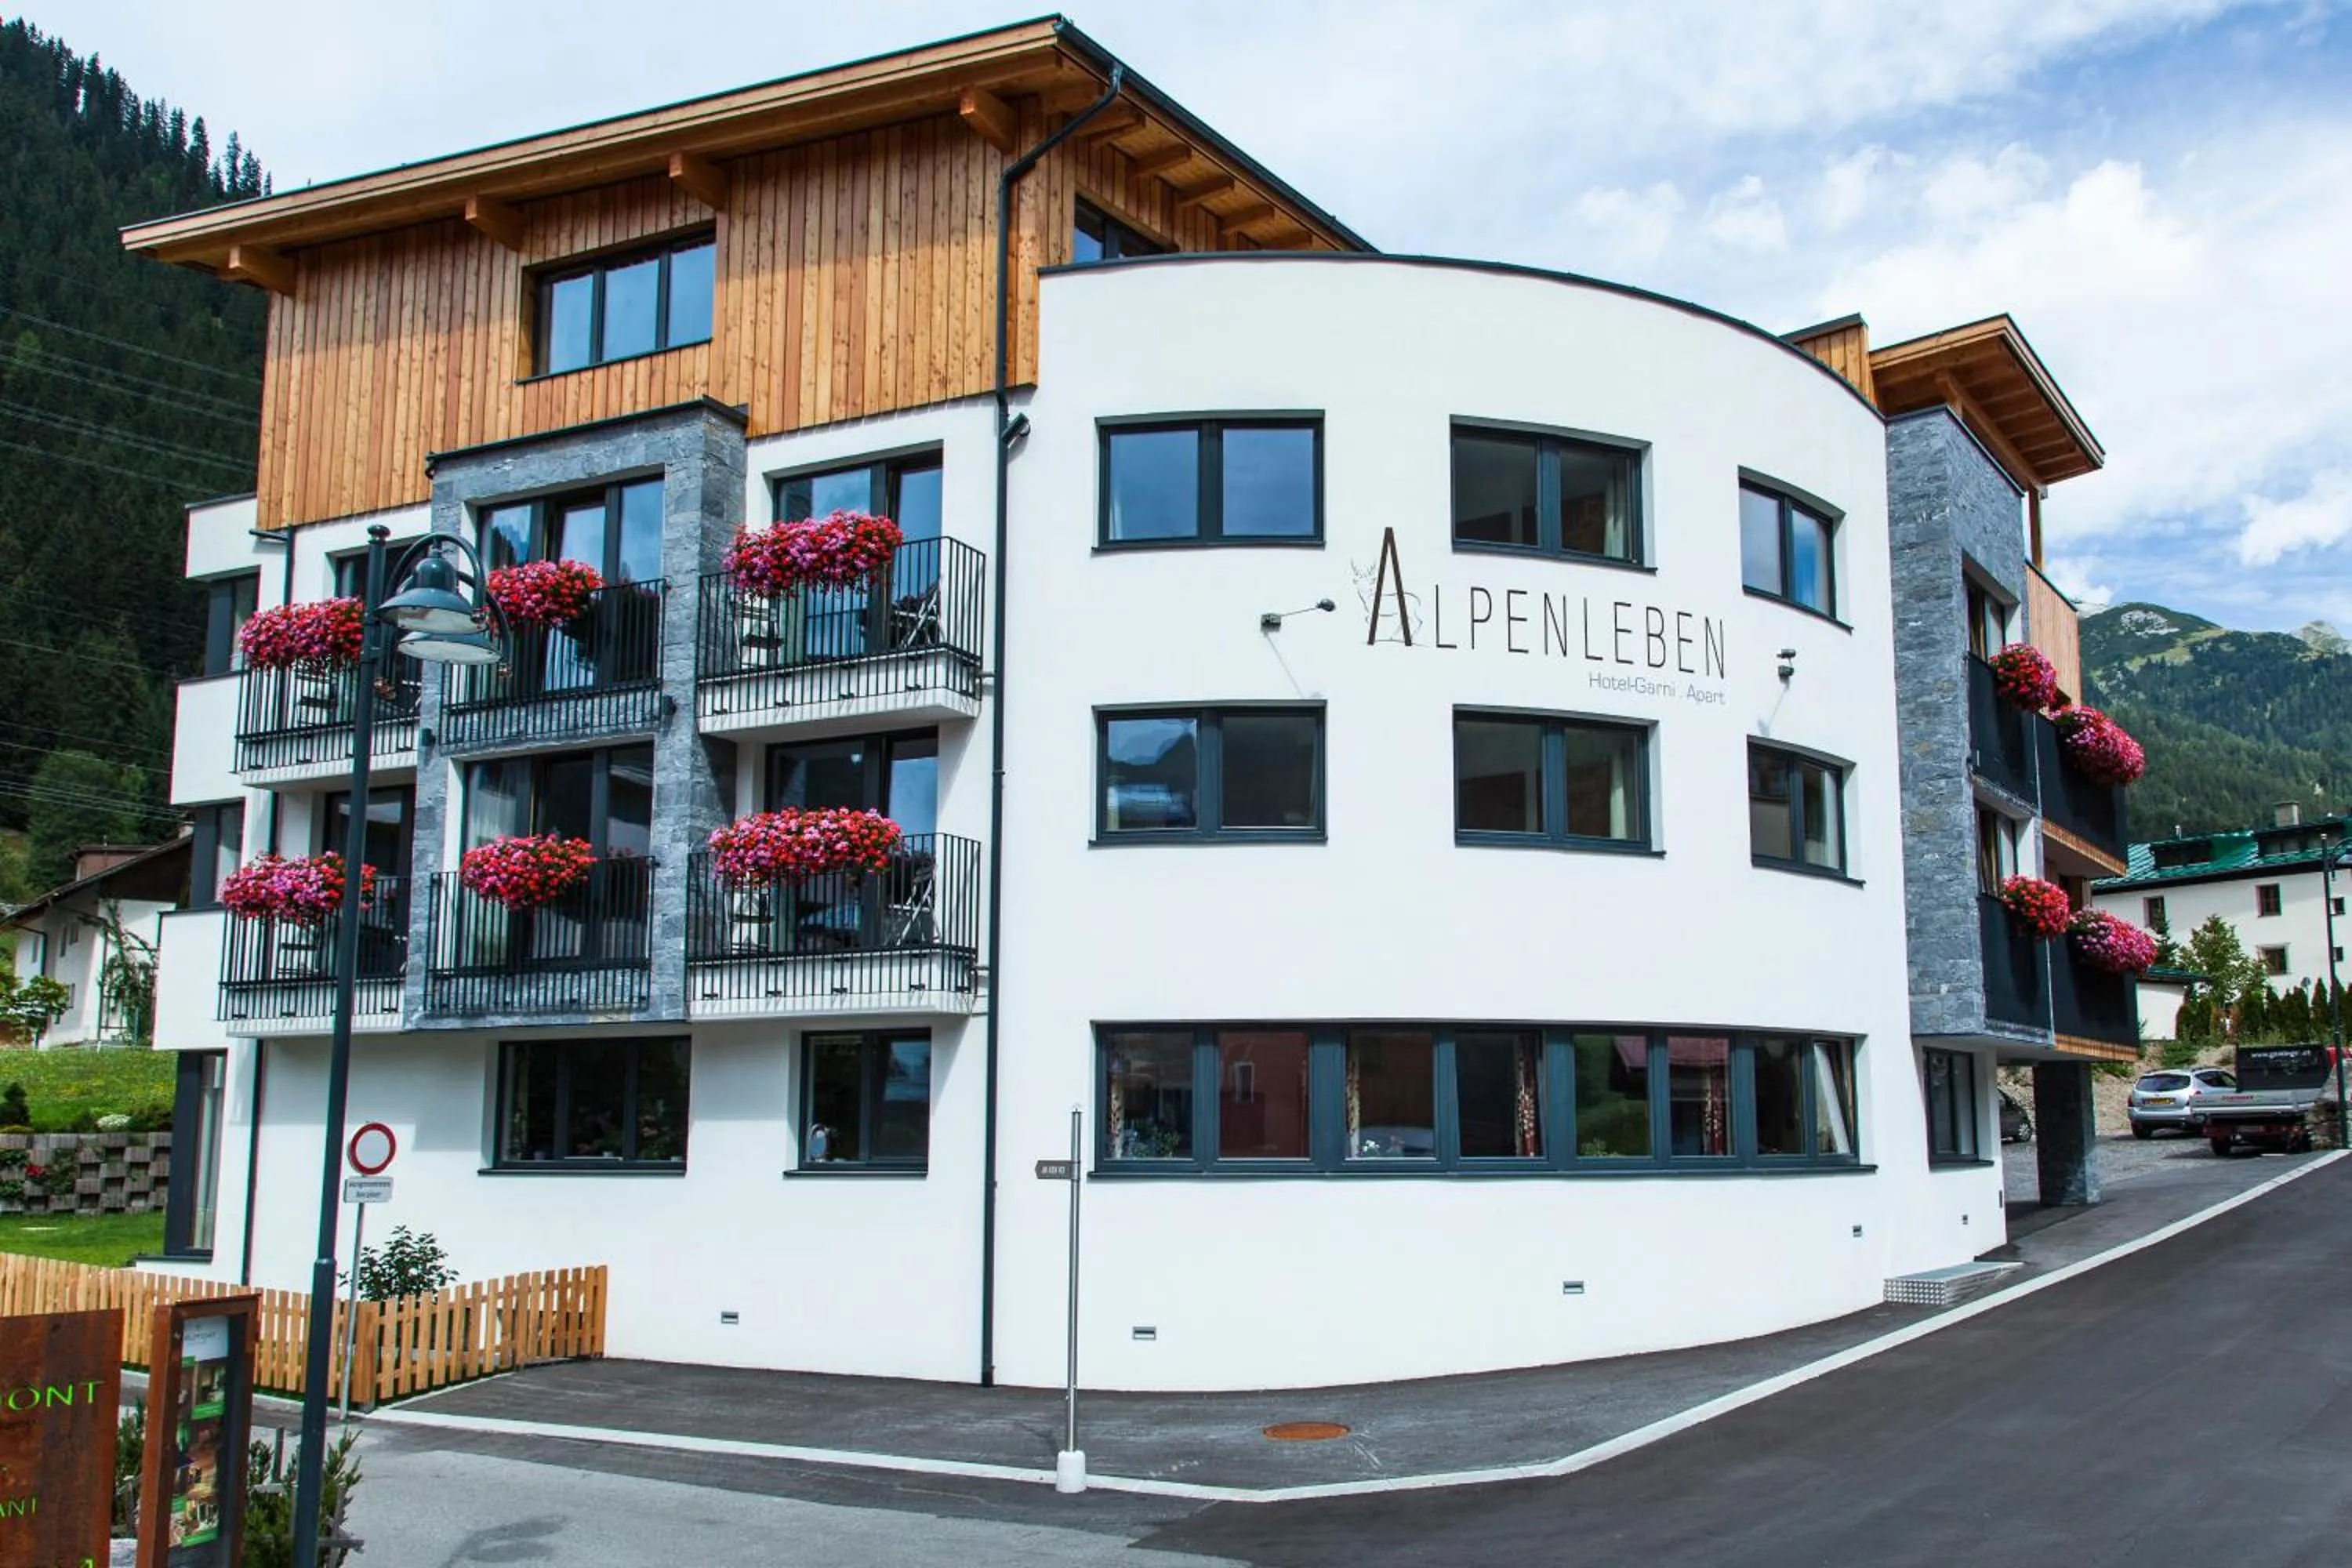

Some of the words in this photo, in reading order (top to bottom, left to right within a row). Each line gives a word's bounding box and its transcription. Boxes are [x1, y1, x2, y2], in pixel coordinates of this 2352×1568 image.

[1367, 526, 1725, 679] ALPENLEBEN
[1686, 684, 1726, 705] Apart
[0, 1380, 104, 1410] ONT
